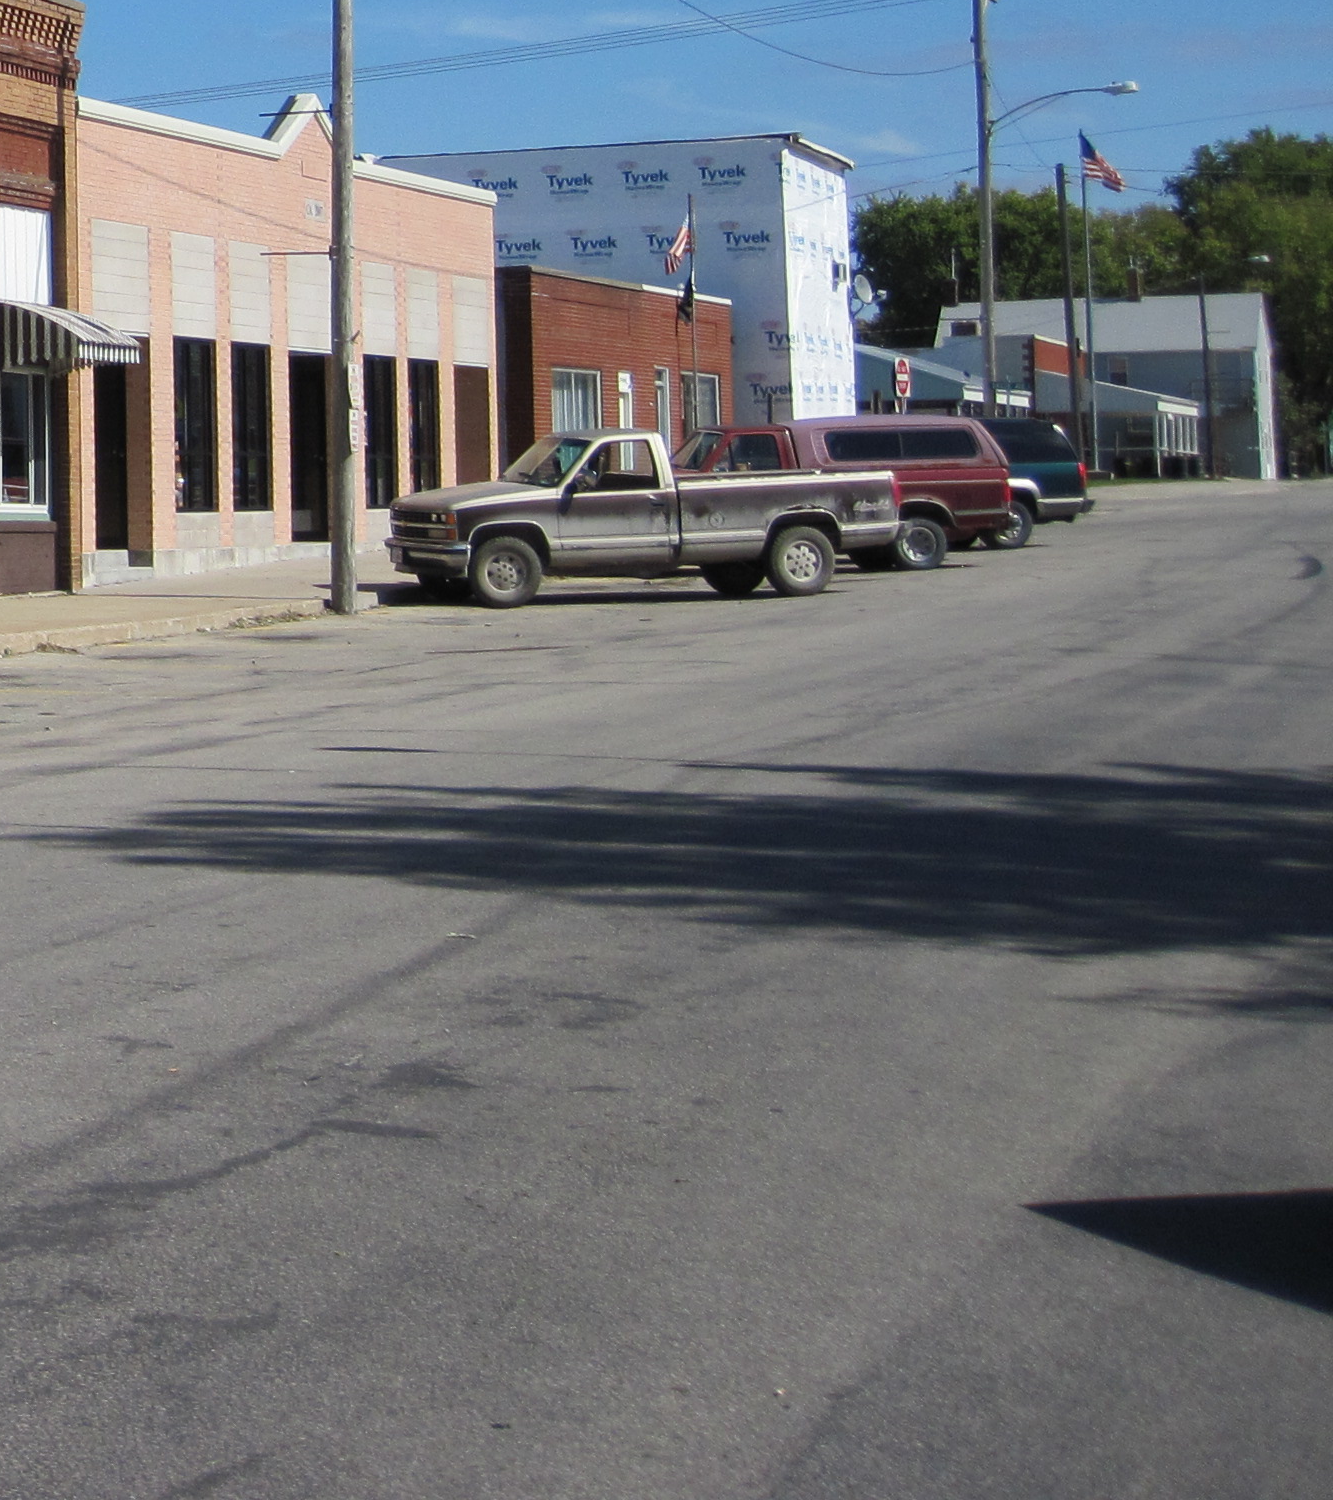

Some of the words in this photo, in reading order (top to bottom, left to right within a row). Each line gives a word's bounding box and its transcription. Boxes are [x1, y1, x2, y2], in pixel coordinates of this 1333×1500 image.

[622, 169, 669, 185] Tyvek
[699, 164, 746, 181] Tyvek
[472, 177, 519, 191] Tyvek
[546, 173, 593, 190] Tyvek
[496, 238, 542, 255] Tyvek
[570, 235, 618, 251] Tyvek
[646, 233, 675, 249] Tyv
[723, 230, 771, 247] Tyvek
